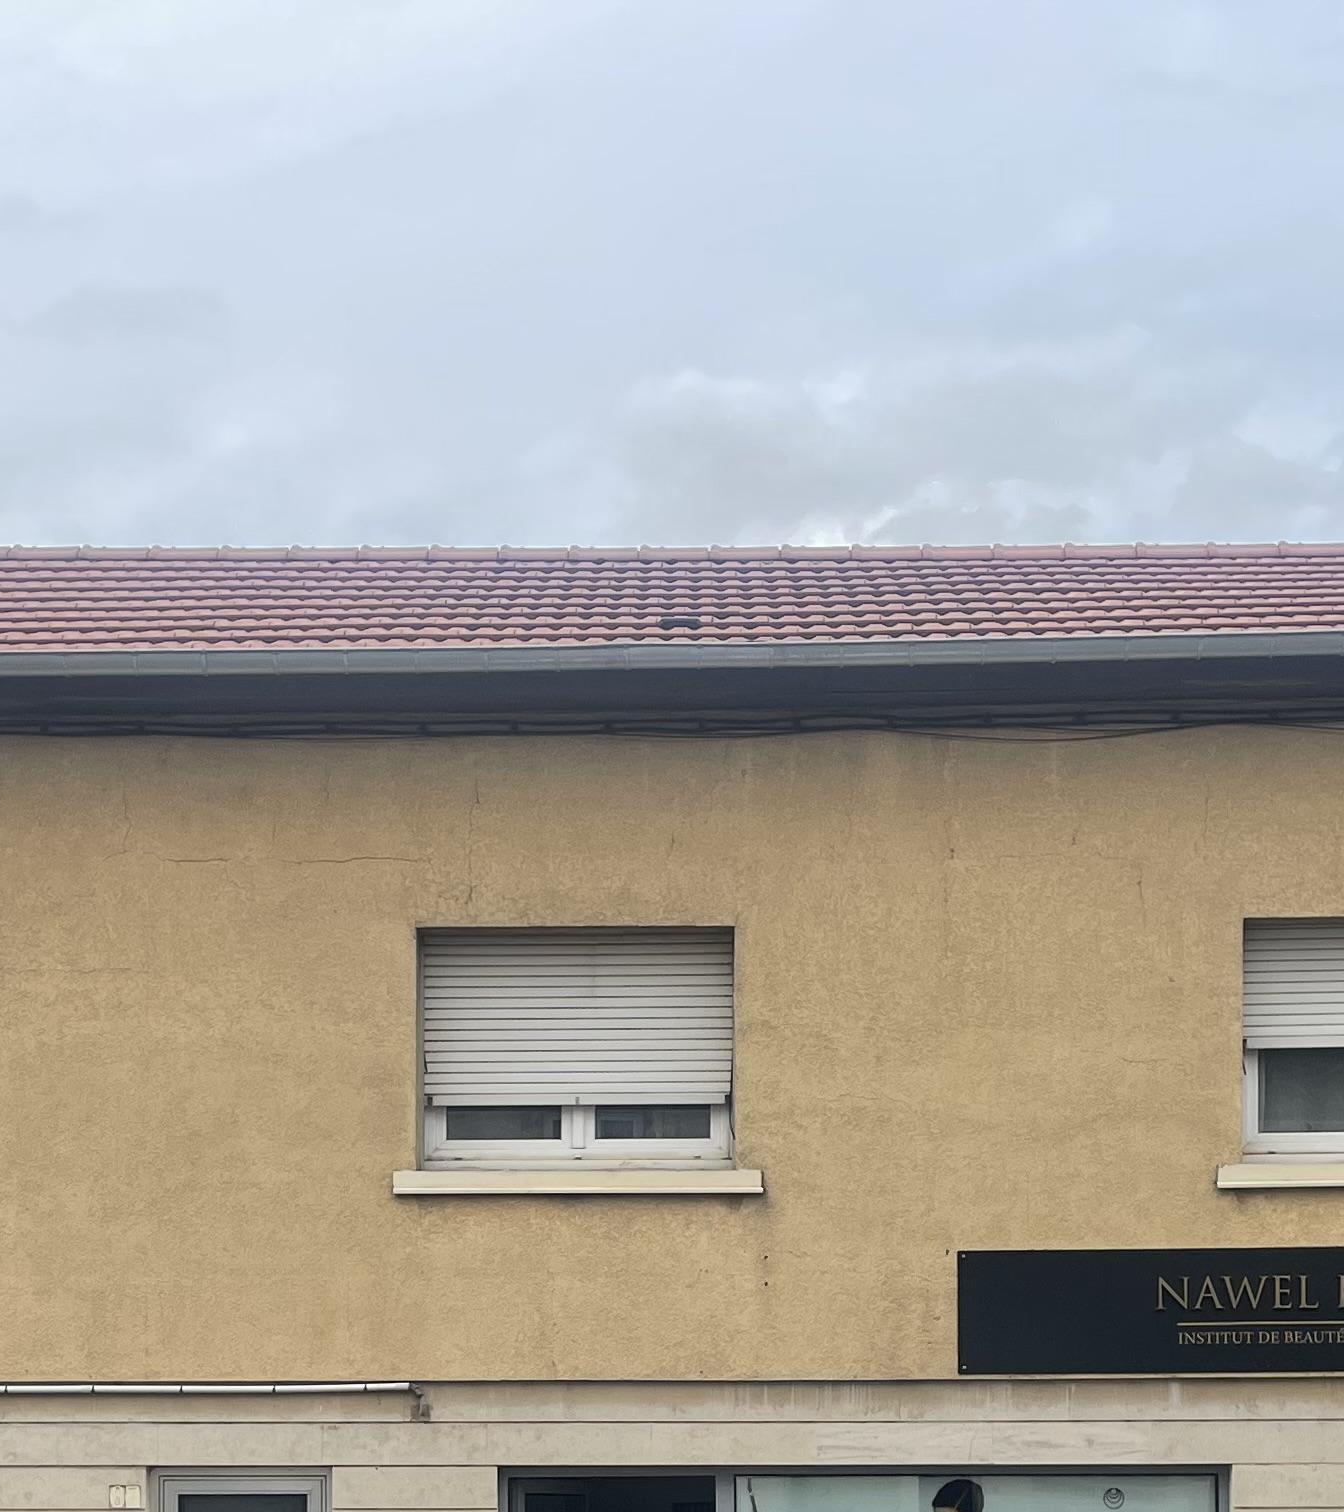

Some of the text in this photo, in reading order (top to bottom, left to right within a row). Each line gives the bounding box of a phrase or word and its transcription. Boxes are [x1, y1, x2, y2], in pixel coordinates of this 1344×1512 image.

[1156, 1274, 1320, 1310] NAWEL
[1178, 1331, 1254, 1345] INSTITUT
[1258, 1330, 1280, 1344] DE
